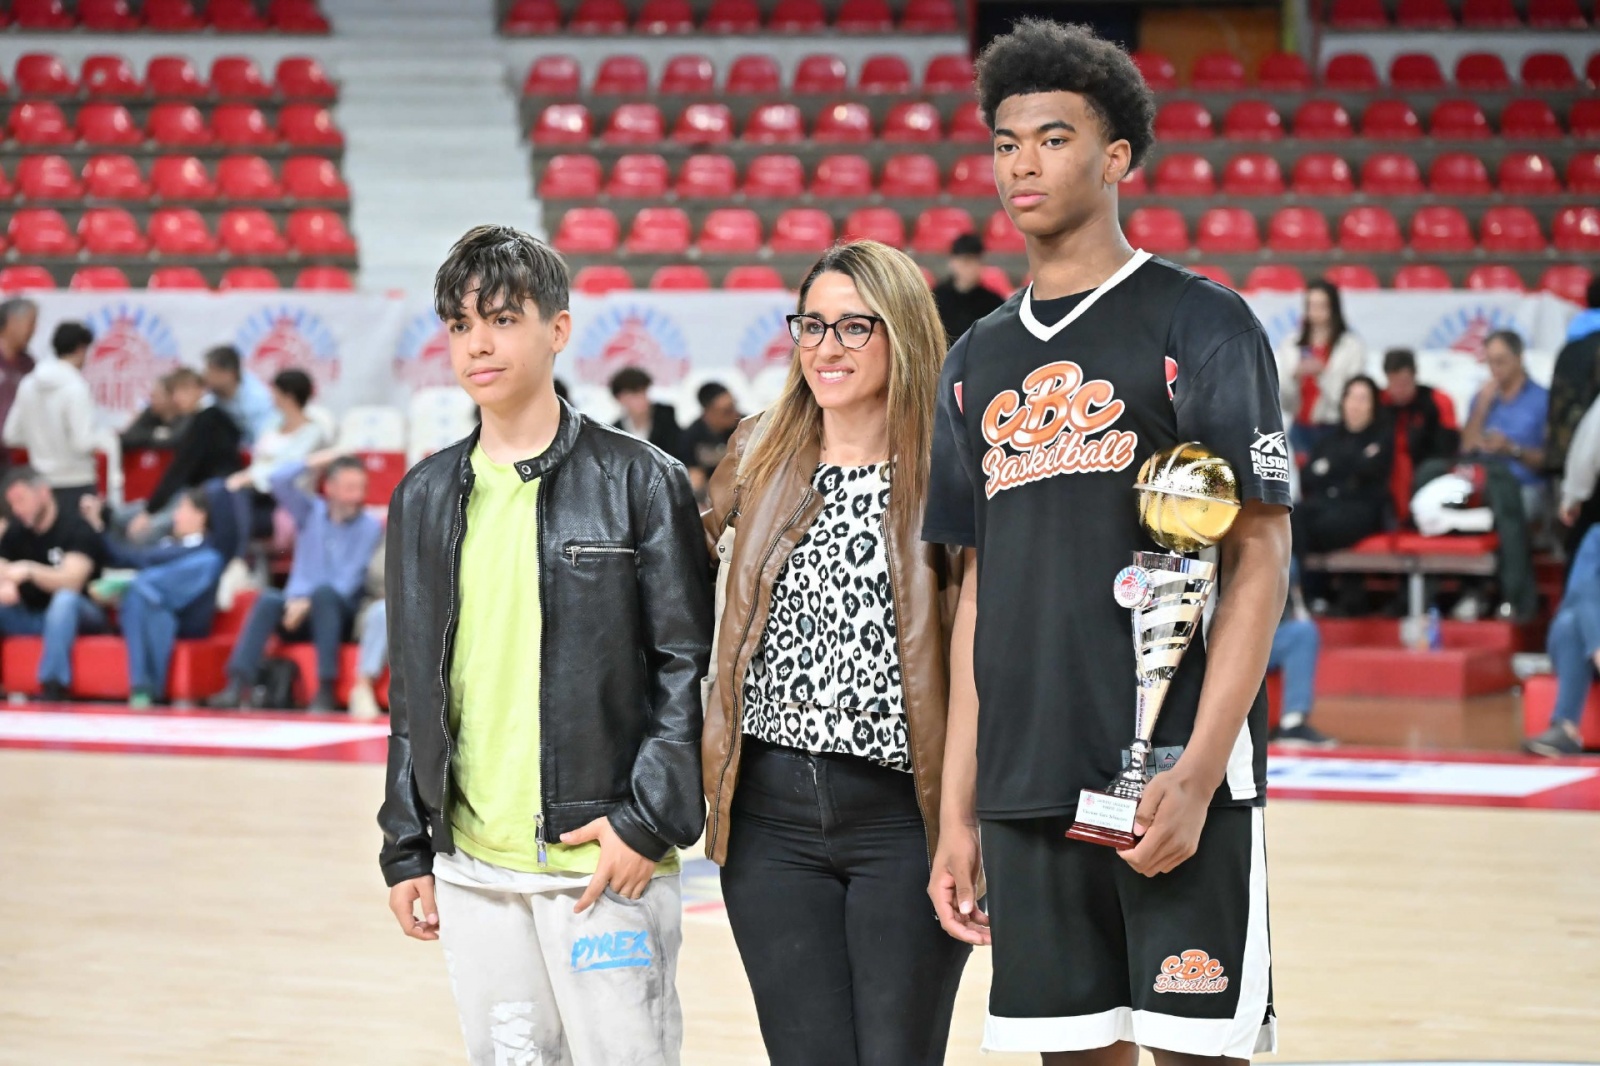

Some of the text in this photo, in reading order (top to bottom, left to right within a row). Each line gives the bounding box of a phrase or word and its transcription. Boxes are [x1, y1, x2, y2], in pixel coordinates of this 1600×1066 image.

[981, 360, 1125, 451] CBC
[982, 430, 1138, 500] Basketball
[571, 930, 653, 968] PYREX
[1161, 949, 1224, 980] CBC
[1153, 975, 1229, 994] Basketball
